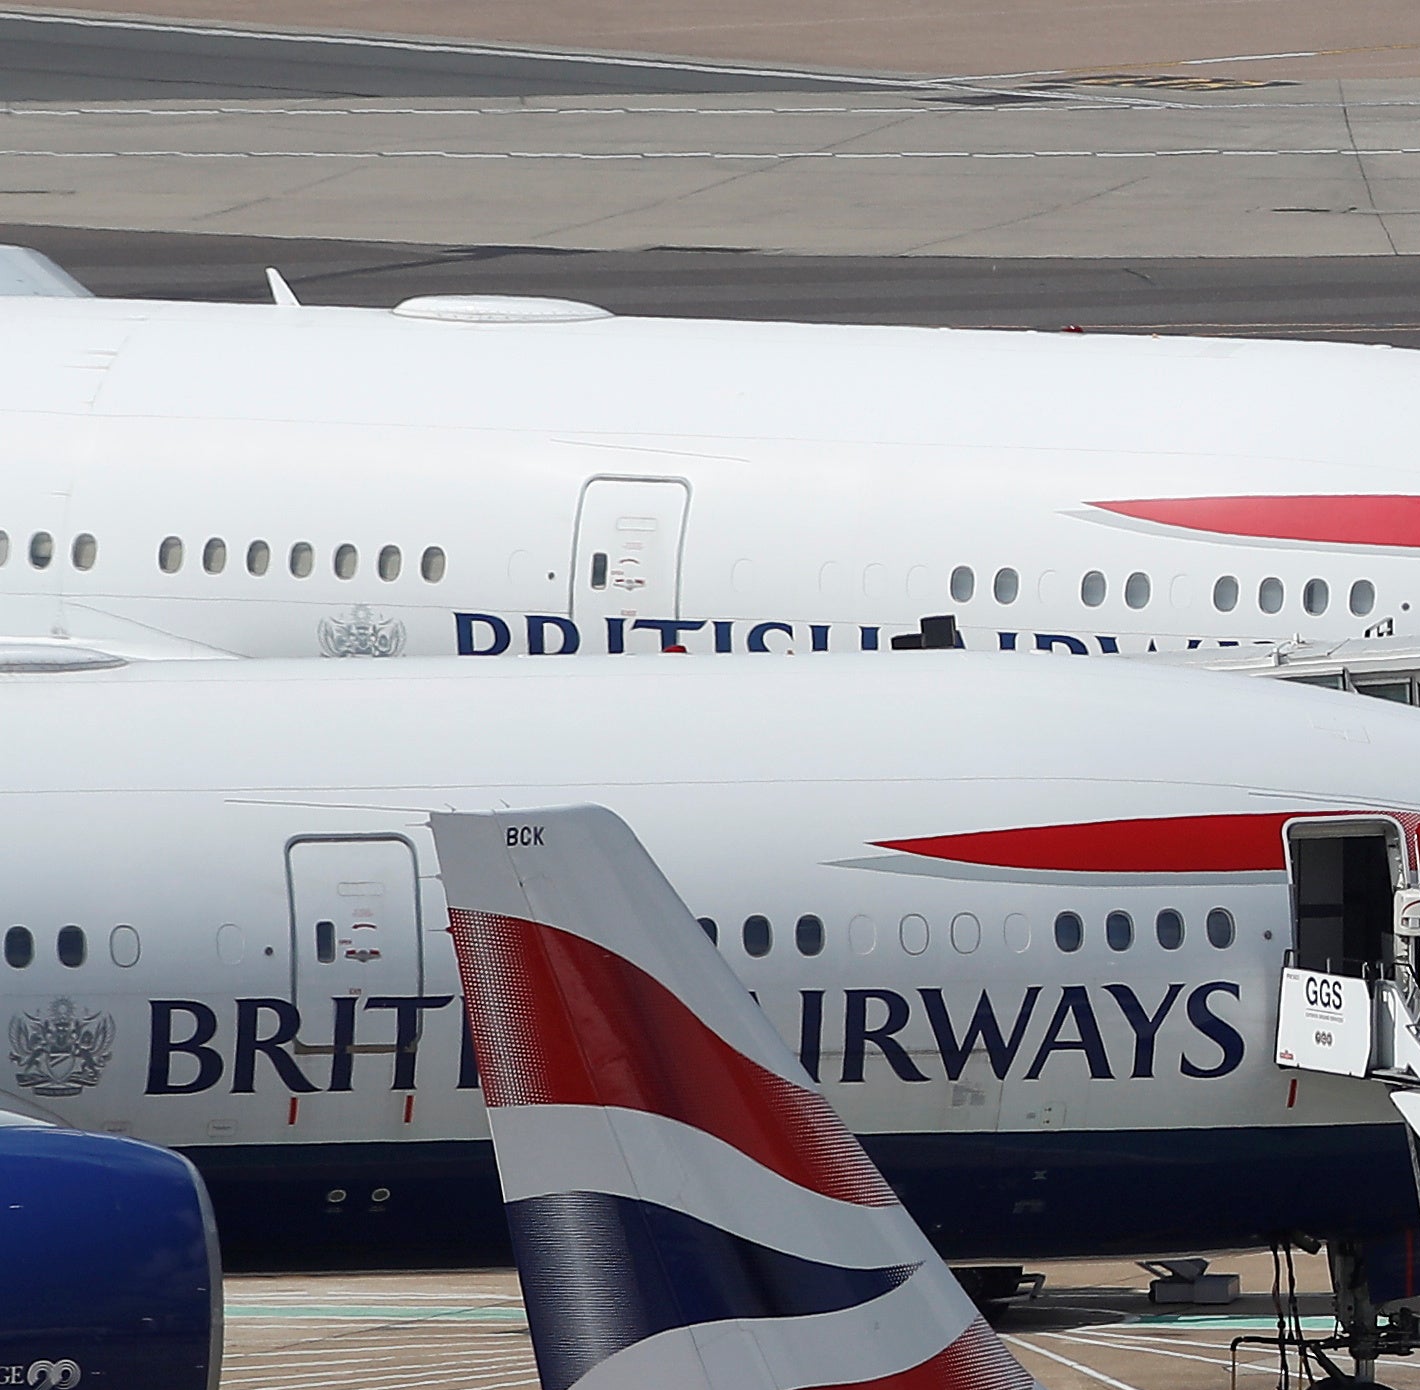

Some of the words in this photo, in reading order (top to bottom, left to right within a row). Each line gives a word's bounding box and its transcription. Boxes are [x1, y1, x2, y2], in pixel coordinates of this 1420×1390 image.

[507, 826, 545, 846] BCK
[1306, 976, 1342, 1010] GGS
[144, 994, 480, 1094] BRITI
[746, 981, 1245, 1084] IRWAYS
